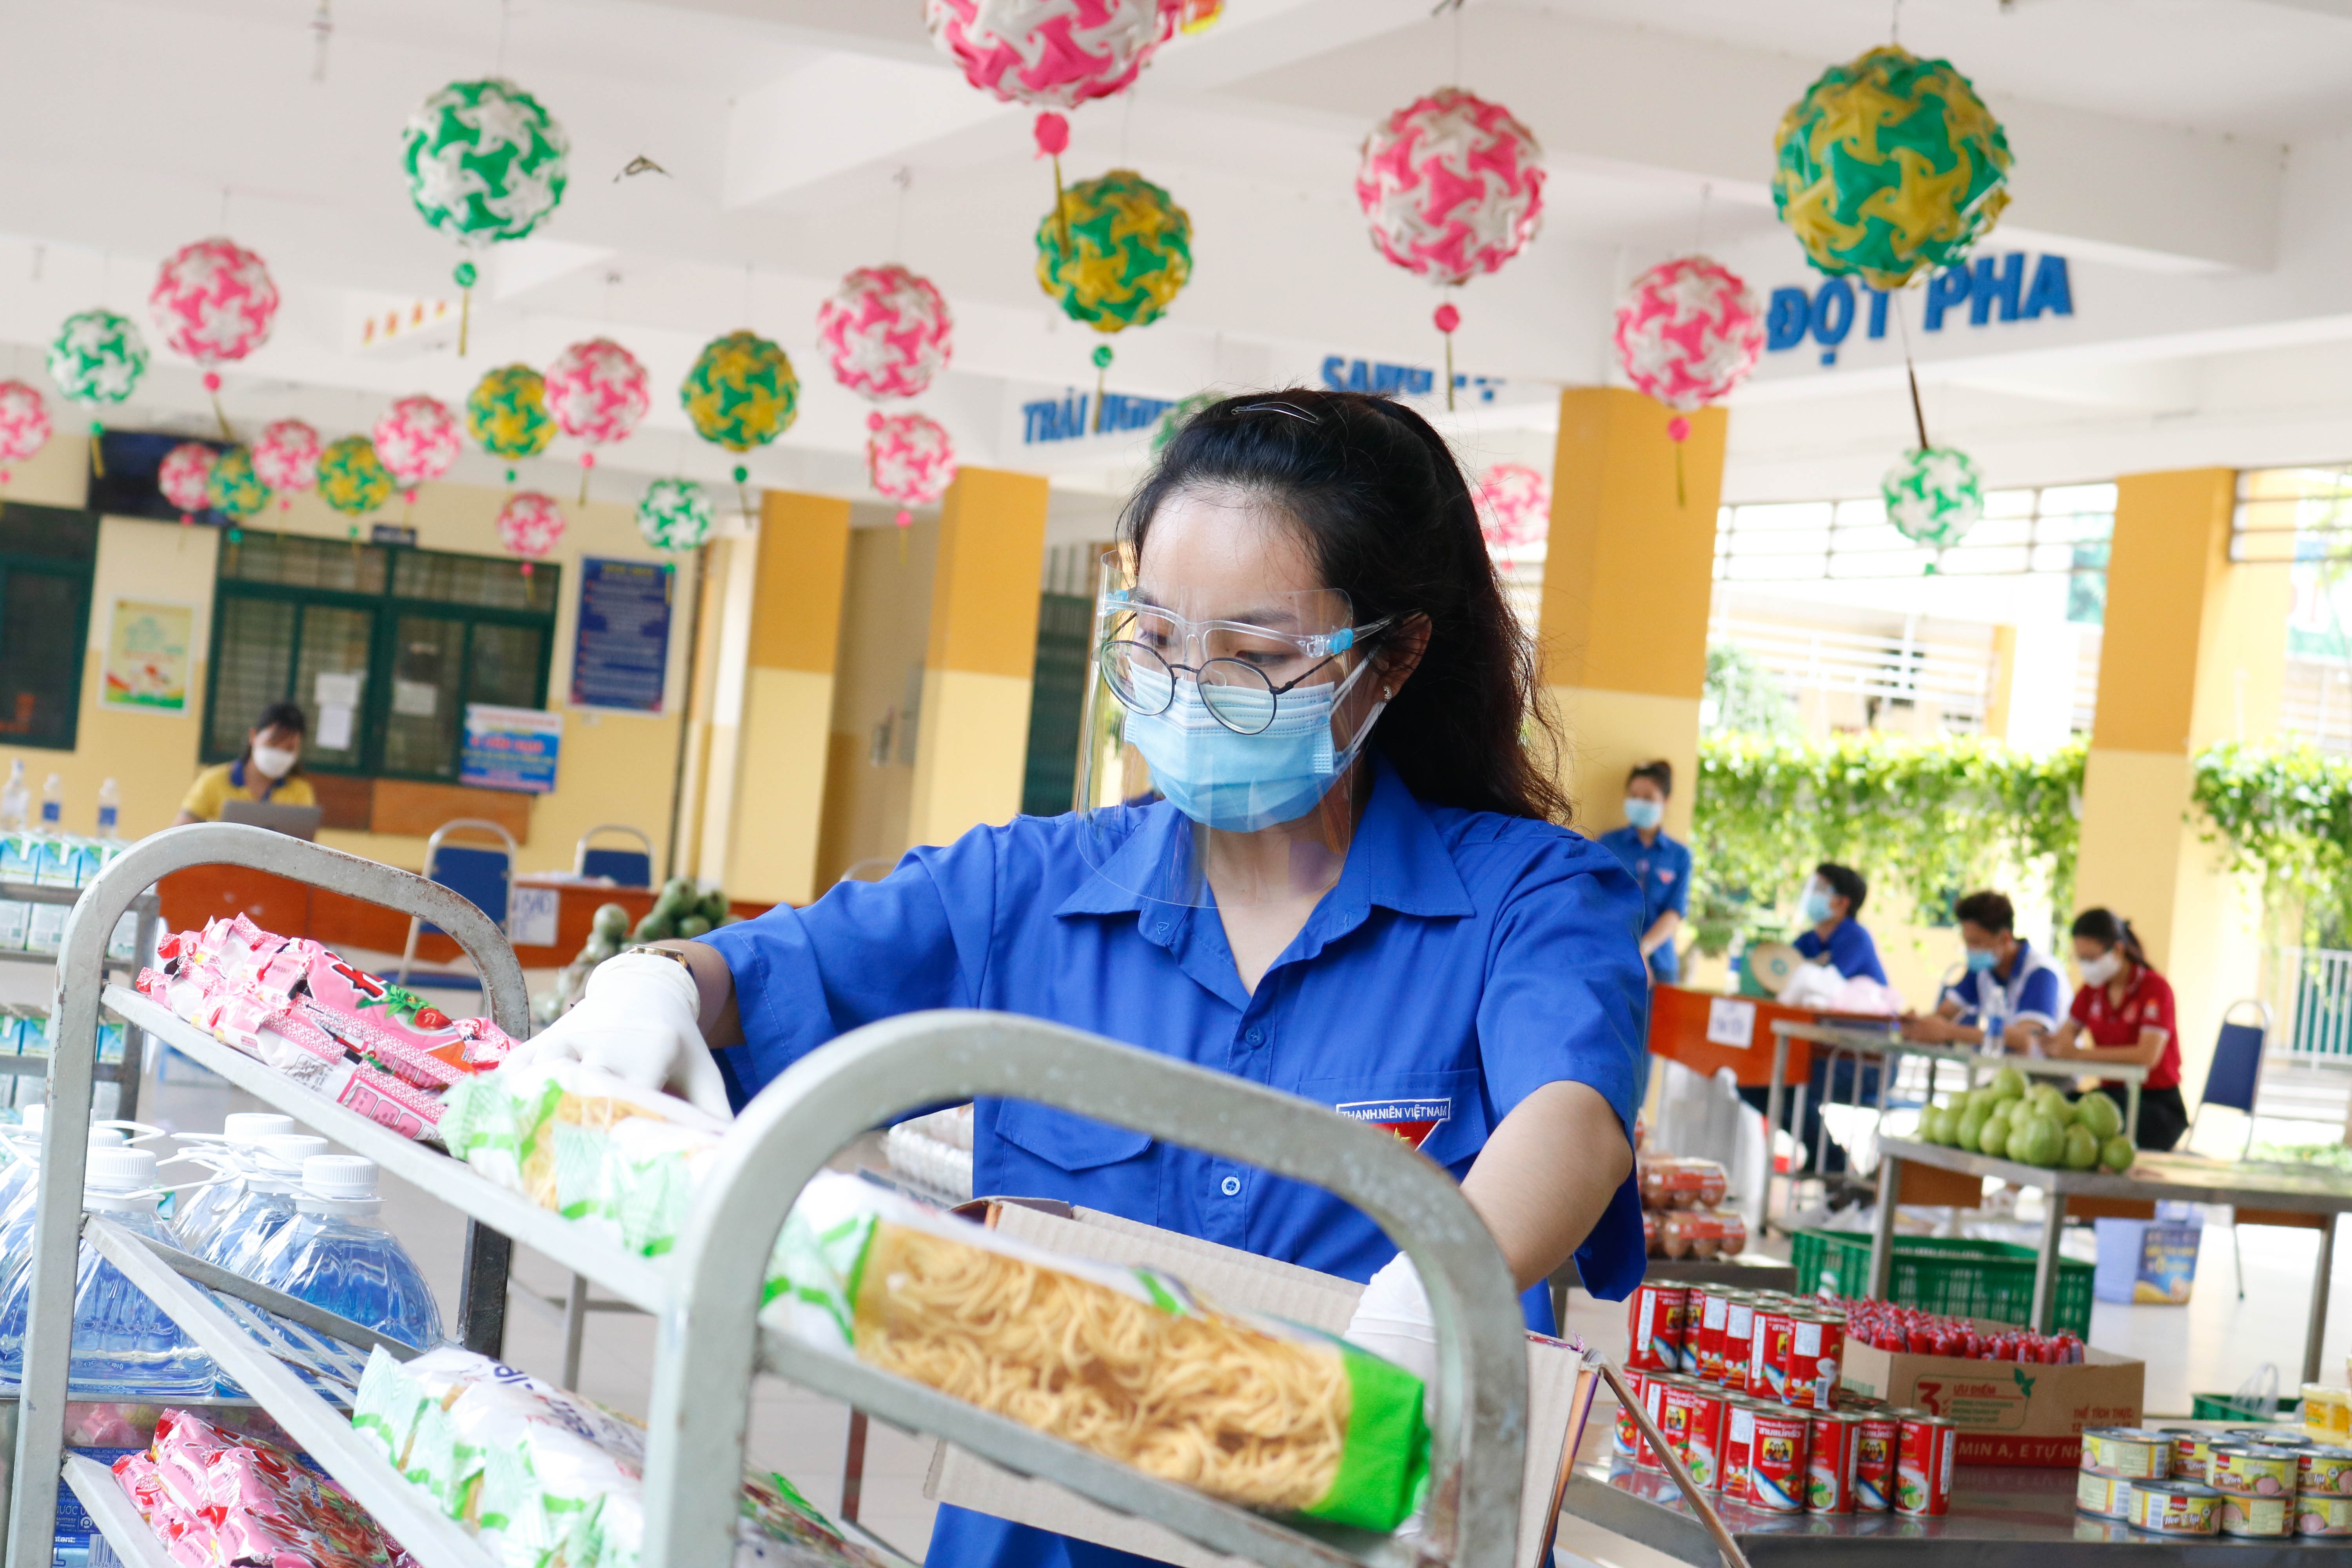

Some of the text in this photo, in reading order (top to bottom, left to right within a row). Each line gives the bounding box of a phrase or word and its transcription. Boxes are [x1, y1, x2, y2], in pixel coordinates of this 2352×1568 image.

[1379, 1105, 1402, 1119] NIÊN
[1404, 1104, 1426, 1120] VIỆT
[1427, 1105, 1446, 1117] NAM
[1917, 1382, 1942, 1417] 3
